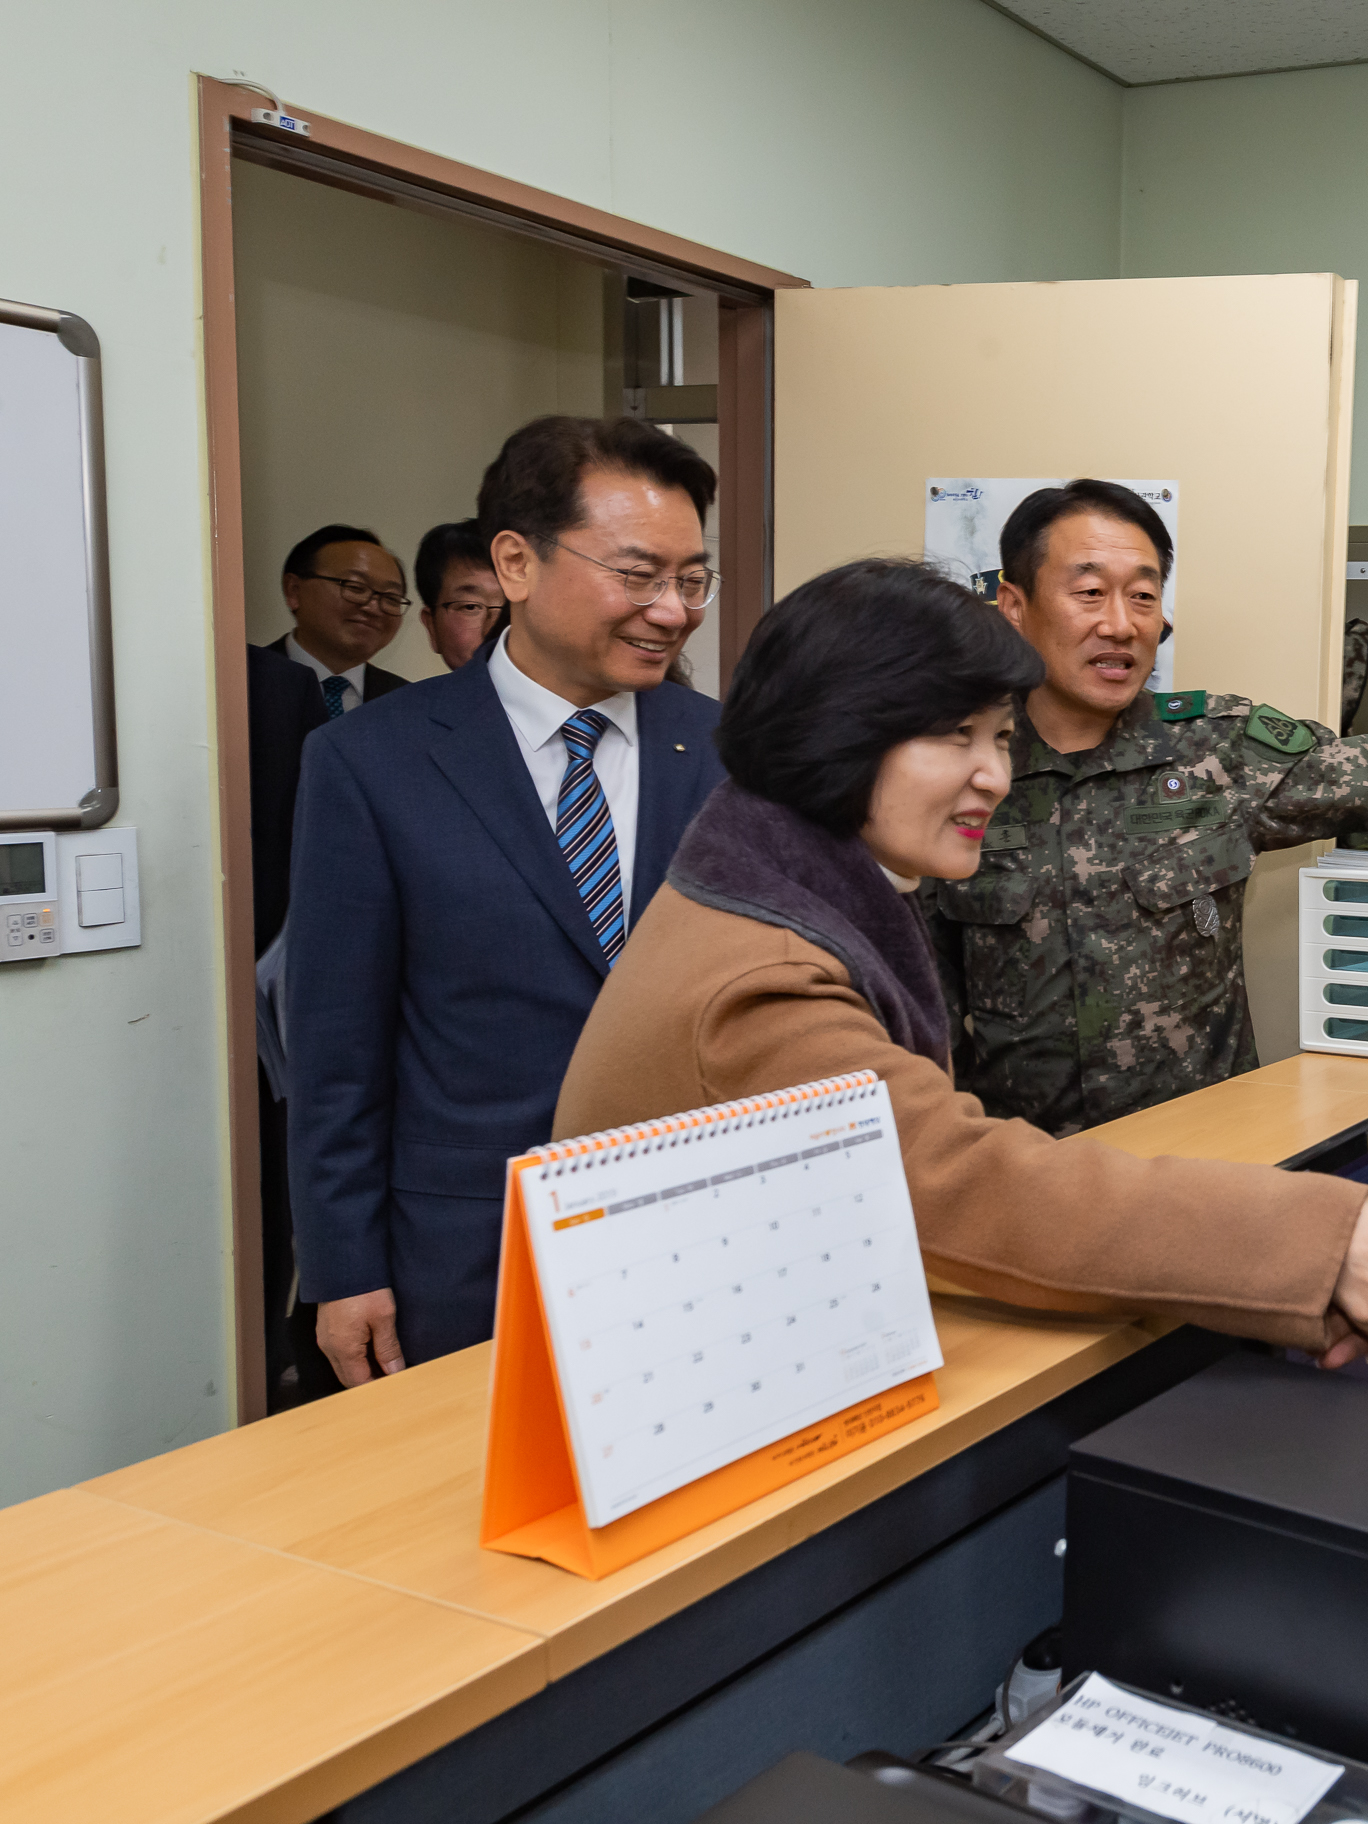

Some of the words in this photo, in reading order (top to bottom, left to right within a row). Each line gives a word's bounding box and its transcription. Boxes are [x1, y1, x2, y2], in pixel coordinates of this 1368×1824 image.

[281, 118, 295, 129] ADT
[1129, 811, 1173, 825] 대한민국
[1174, 808, 1194, 820] 육군
[1195, 806, 1220, 819] ROKA
[549, 1190, 560, 1213] 1
[1073, 1693, 1101, 1712] HP
[1105, 1706, 1200, 1748] OFFICEJET
[1202, 1740, 1284, 1777] PRO8600
